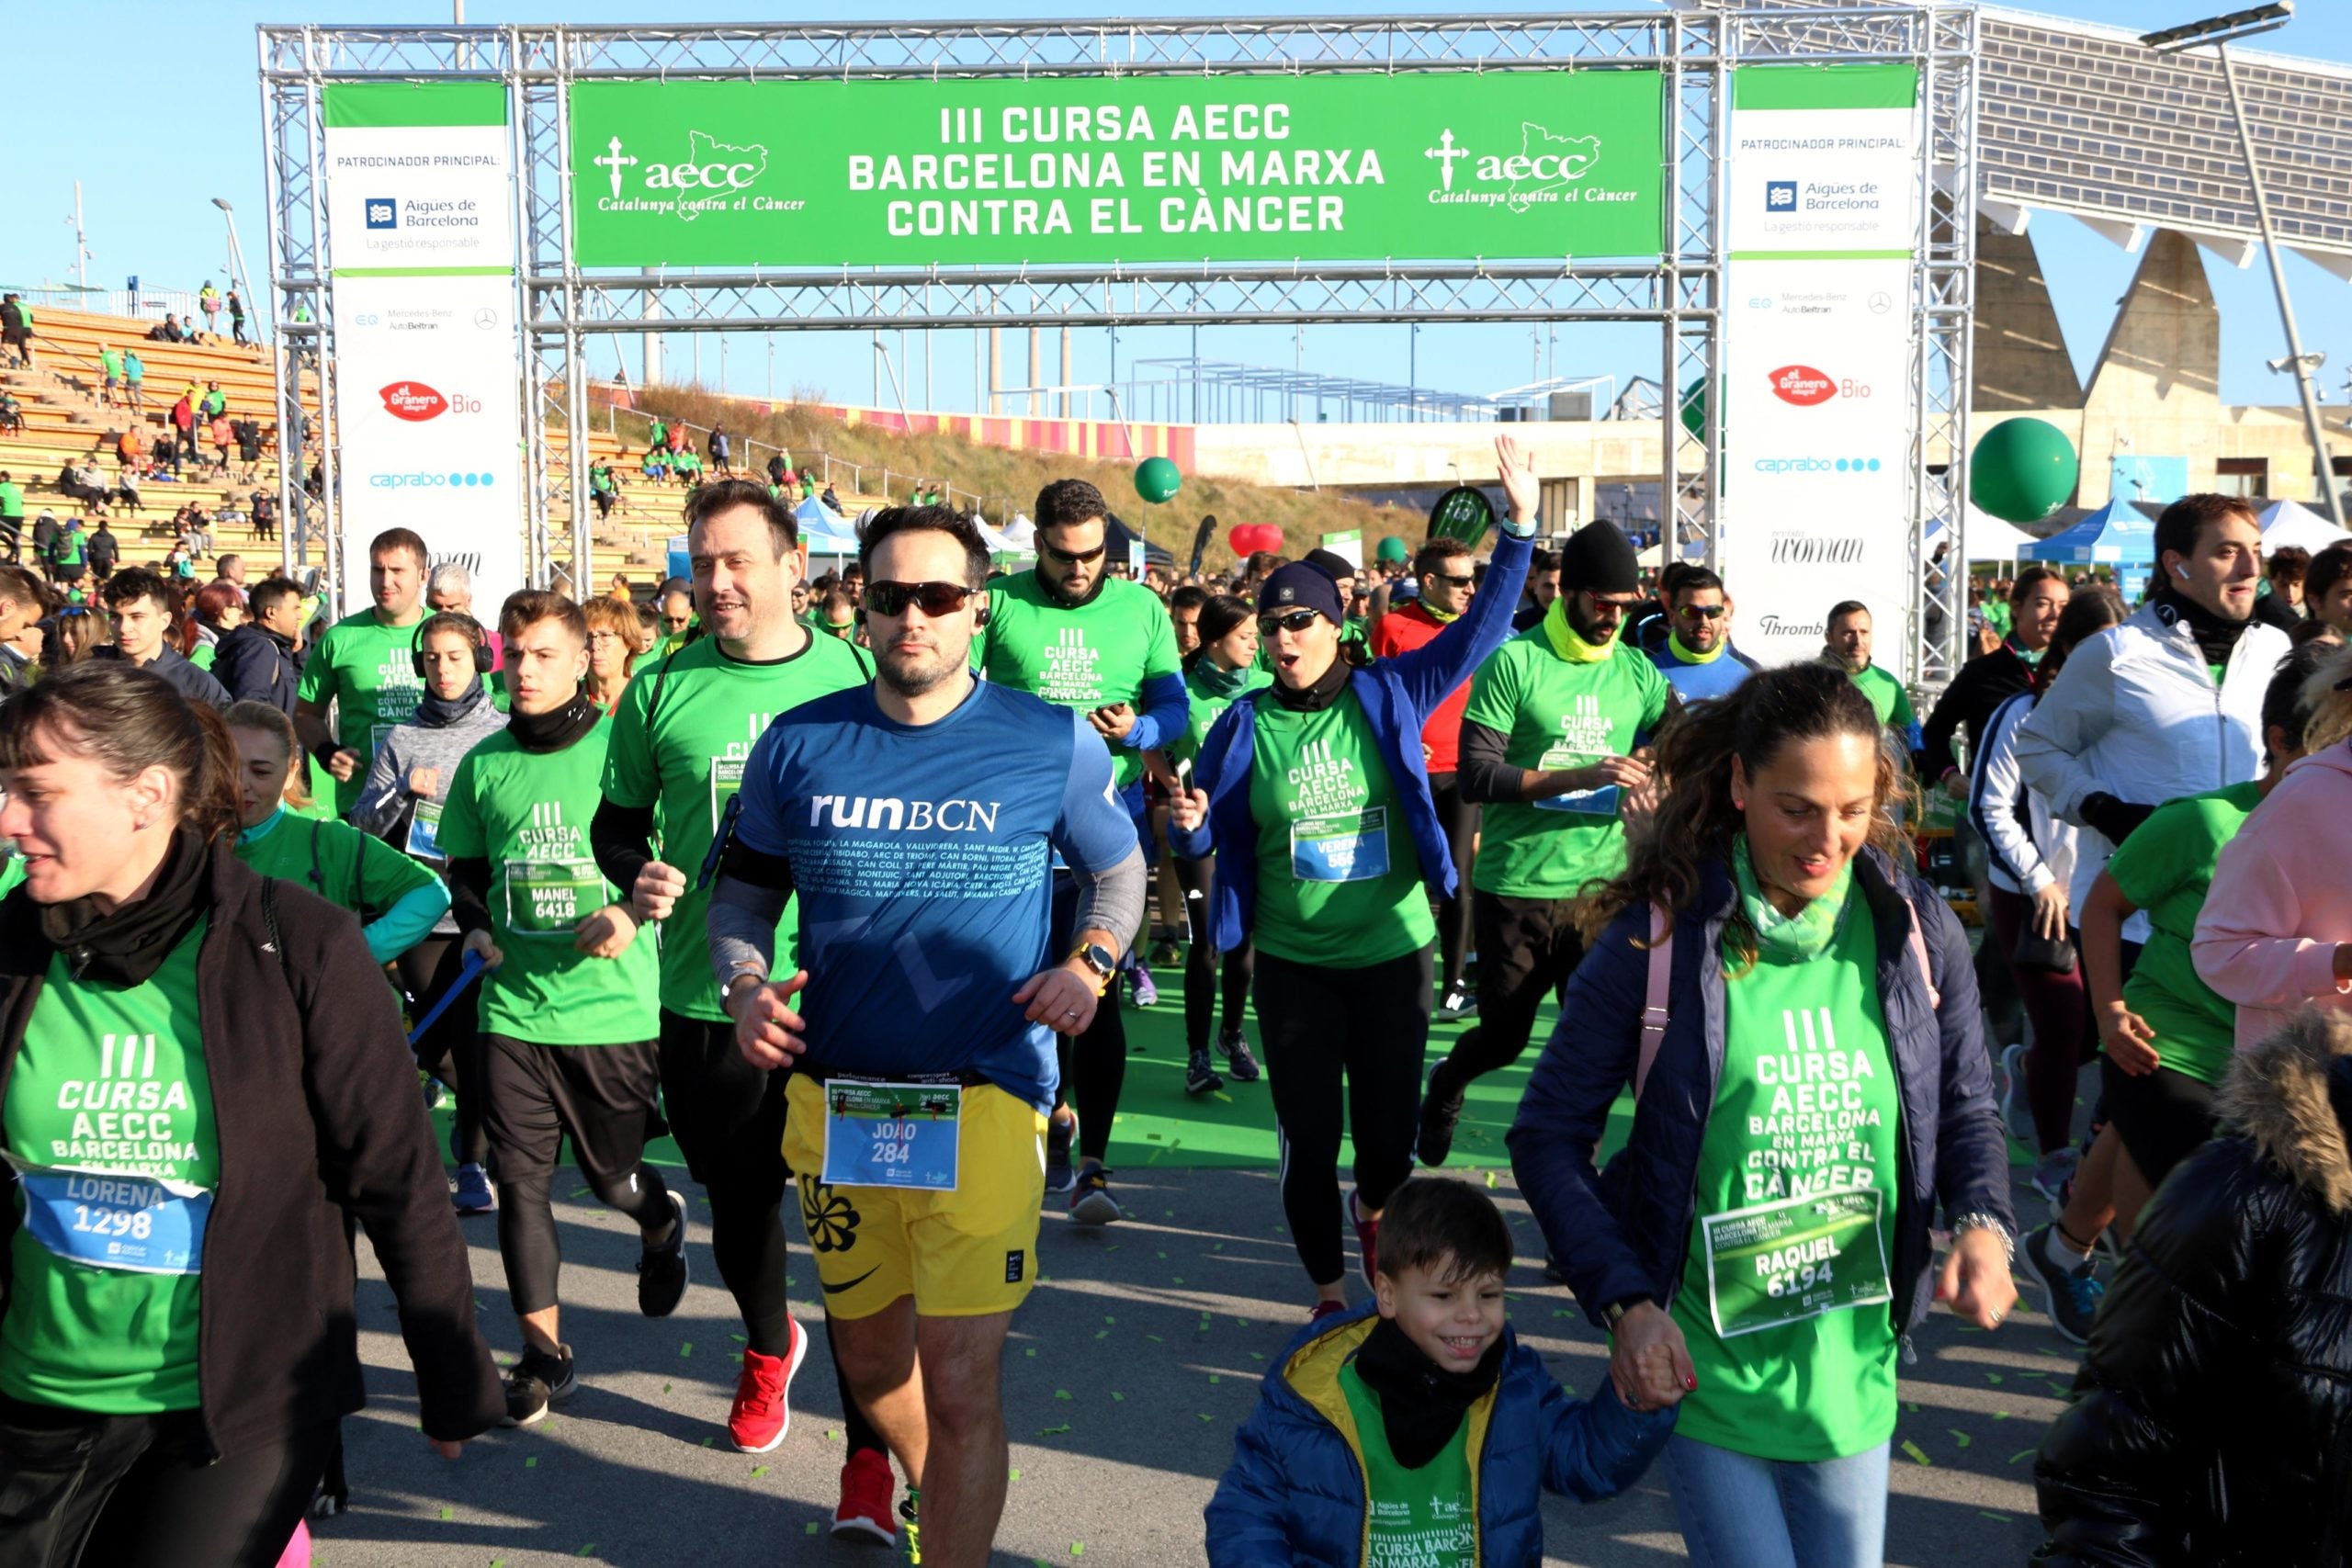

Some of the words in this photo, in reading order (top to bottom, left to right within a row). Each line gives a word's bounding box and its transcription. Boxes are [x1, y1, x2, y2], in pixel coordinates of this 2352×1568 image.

[941, 107, 982, 143] III
[1002, 106, 1155, 143] CURSA
[1170, 104, 1290, 140] AECC
[1741, 139, 1835, 151] PATROCINADOR
[1838, 137, 1906, 149] PRINCIPAL:
[337, 157, 431, 168] PATROCINADOR
[434, 155, 502, 167] PRINCIPAL:
[849, 152, 1125, 191] BARCELONA
[1144, 152, 1201, 186] EN
[1221, 149, 1385, 186] MARXA
[1476, 152, 1587, 181] aecc
[645, 163, 755, 189] aecc
[1428, 188, 1507, 209] Catalunya
[1512, 191, 1558, 203] contra
[1565, 188, 1579, 203] el
[1585, 186, 1638, 203] Càncer
[1804, 181, 1855, 198] Aigües
[1857, 181, 1879, 195] de
[405, 199, 453, 216] Aigües
[457, 198, 477, 212] de
[598, 197, 675, 216] Catalunya
[681, 199, 727, 212] contra
[733, 197, 747, 211] el
[752, 196, 806, 212] Càncer
[888, 199, 1073, 236] CONTRA
[1091, 198, 1143, 233] EL
[1159, 187, 1345, 232] CÀNCER
[1804, 195, 1881, 211] Barcelona
[406, 212, 479, 228] Barcelona
[1764, 221, 1778, 233] La
[1814, 220, 1880, 234] responsable
[367, 238, 379, 250] La
[379, 236, 413, 252] gestió
[415, 236, 481, 251] responsable
[1781, 292, 1848, 302] Mercedes-Benz
[388, 309, 454, 319] Mercedes-Benz
[1780, 377, 1828, 389] Granero
[1787, 369, 1801, 380] el
[399, 385, 411, 397] el
[1841, 378, 1871, 398] Bio
[390, 395, 438, 406] Granero
[453, 395, 482, 414] Bio
[1755, 457, 1832, 475] caprabo
[370, 471, 447, 491] caprabo
[1770, 537, 1864, 564] woman
[1759, 615, 1824, 636] Thromb
[1060, 627, 1083, 647] III
[390, 648, 411, 663] III
[1044, 646, 1100, 660] CURSA
[378, 663, 415, 675] CURS
[1049, 660, 1093, 672] AECC
[1039, 671, 1102, 682] BARCELONA
[378, 697, 414, 705] CONTRA
[1577, 694, 1599, 716] III
[1561, 715, 1613, 732] CURSA
[1565, 729, 1606, 744] AECC
[1303, 738, 1331, 765] III
[1287, 757, 1354, 784] CURSA
[1298, 773, 1350, 798] AECC
[1287, 784, 1366, 813] BARCELONA
[533, 801, 561, 828] III
[1304, 807, 1317, 818] EN
[1319, 800, 1354, 815] MARXA
[519, 825, 582, 845] CURSA
[526, 842, 576, 859] AECC
[964, 843, 985, 852] SANT
[1317, 836, 1365, 854] VERENA
[873, 852, 891, 860] ARC
[857, 861, 877, 869] CAN
[972, 863, 989, 872] PAU
[872, 880, 900, 888] MARIA
[903, 880, 929, 889] NOVA
[532, 887, 577, 901] MANEL
[536, 902, 576, 919] 6418
[1446, 993, 1464, 1010] N
[1782, 1007, 1837, 1052] III
[100, 1033, 156, 1079] III
[1756, 1049, 1874, 1086] CURSA
[56, 1080, 189, 1111] CURSA
[856, 1089, 872, 1098] AECC
[1770, 1080, 1862, 1115] AECC
[72, 1111, 173, 1142] AECC
[1748, 1108, 1882, 1136] BARCELONA
[1771, 1134, 1796, 1149] EN
[1801, 1127, 1856, 1149] MARXA
[51, 1139, 201, 1163] BARCELONA
[871, 1143, 910, 1164] 284
[1747, 1145, 1840, 1169] CONTRA
[1847, 1141, 1876, 1163] EL
[1745, 1164, 1875, 1201] CÀNCER
[66, 1175, 167, 1212] LORENA
[73, 1204, 153, 1240] 1298
[1713, 1226, 1758, 1244] BARCELONA
[1755, 1235, 1841, 1277] RAQUEL
[1767, 1260, 1834, 1298] 6194
[1377, 1508, 1410, 1517] Barcelona
[1375, 1541, 1422, 1556] CURSA
[1387, 1552, 1441, 1568] MARXA
